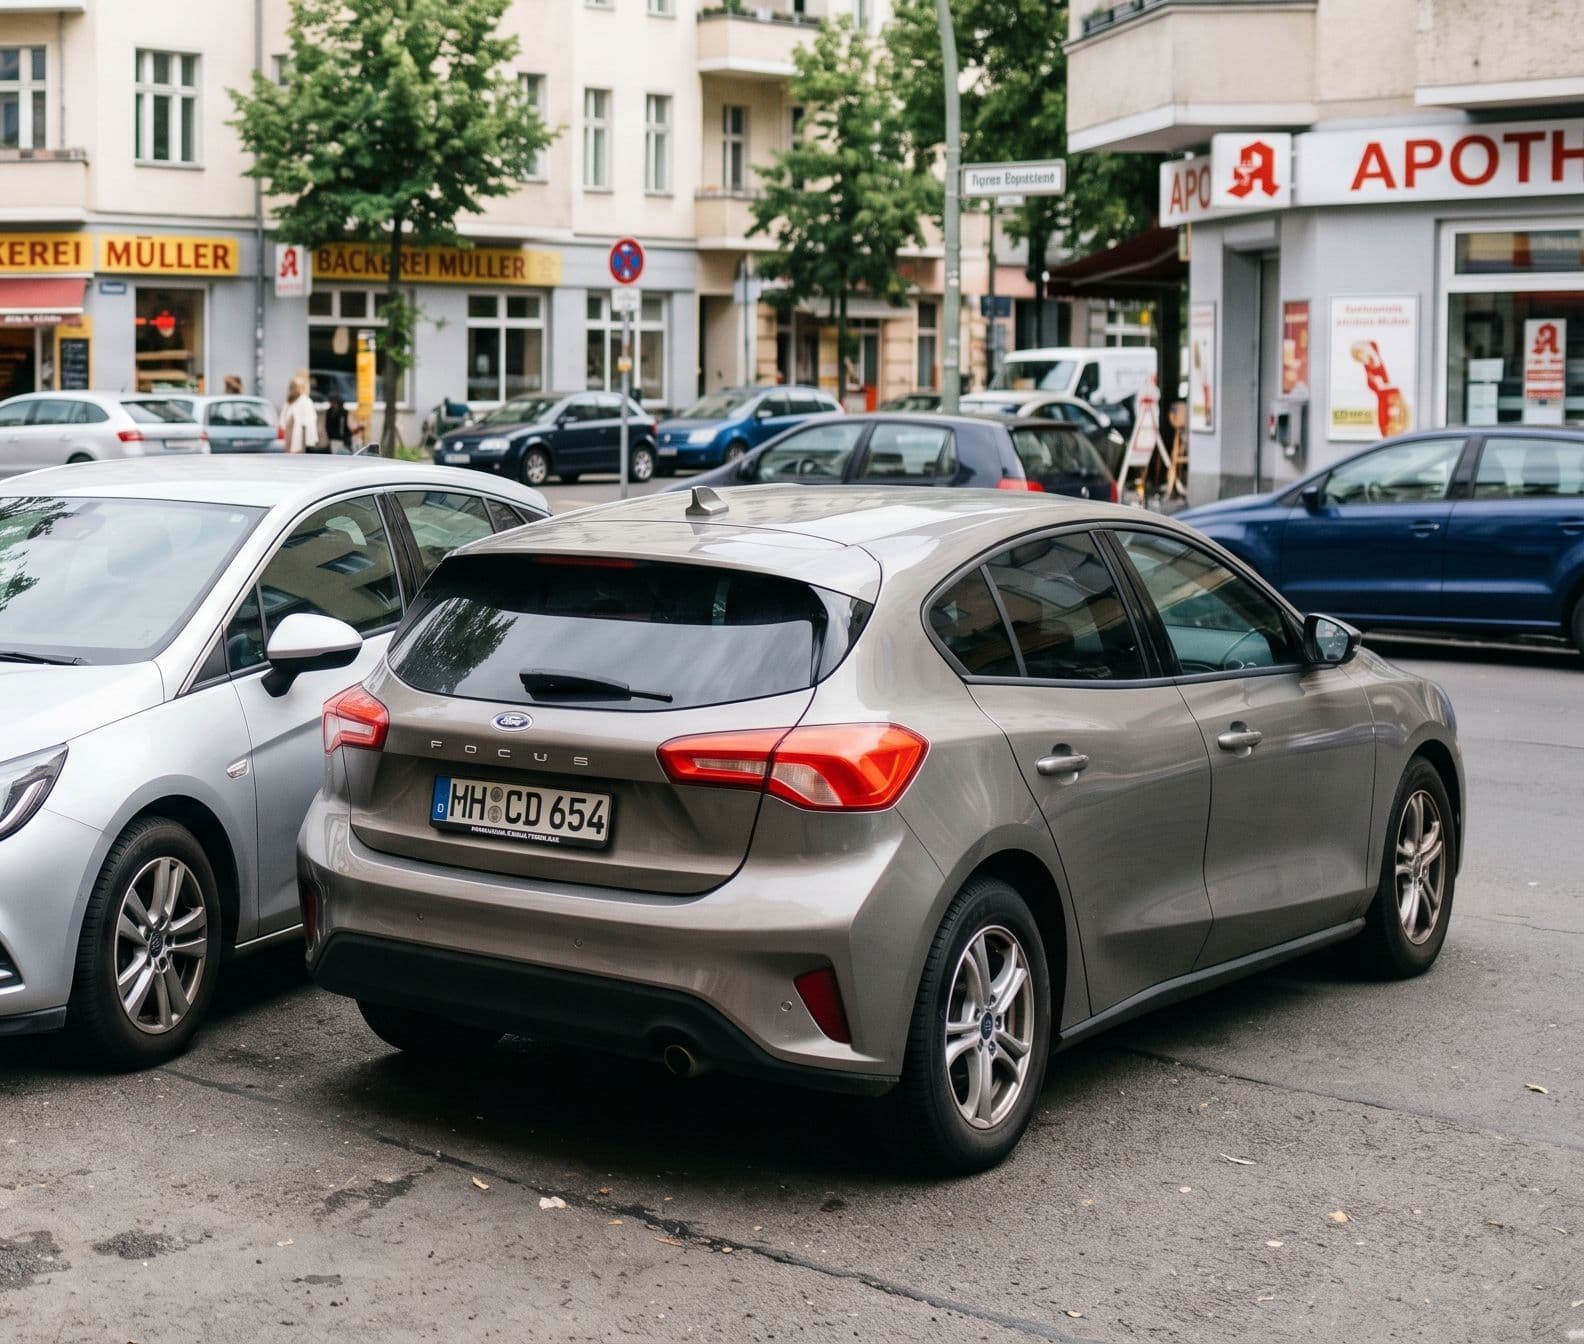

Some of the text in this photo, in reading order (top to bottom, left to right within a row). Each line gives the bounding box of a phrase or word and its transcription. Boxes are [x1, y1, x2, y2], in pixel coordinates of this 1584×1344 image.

[1351, 130, 1584, 191] APOTH
[1169, 165, 1212, 216] APO
[107, 236, 230, 270] MÜLLER
[430, 740, 589, 766] FOCUS
[450, 783, 487, 820] MH
[505, 790, 542, 826] CD
[549, 796, 604, 835] 654
